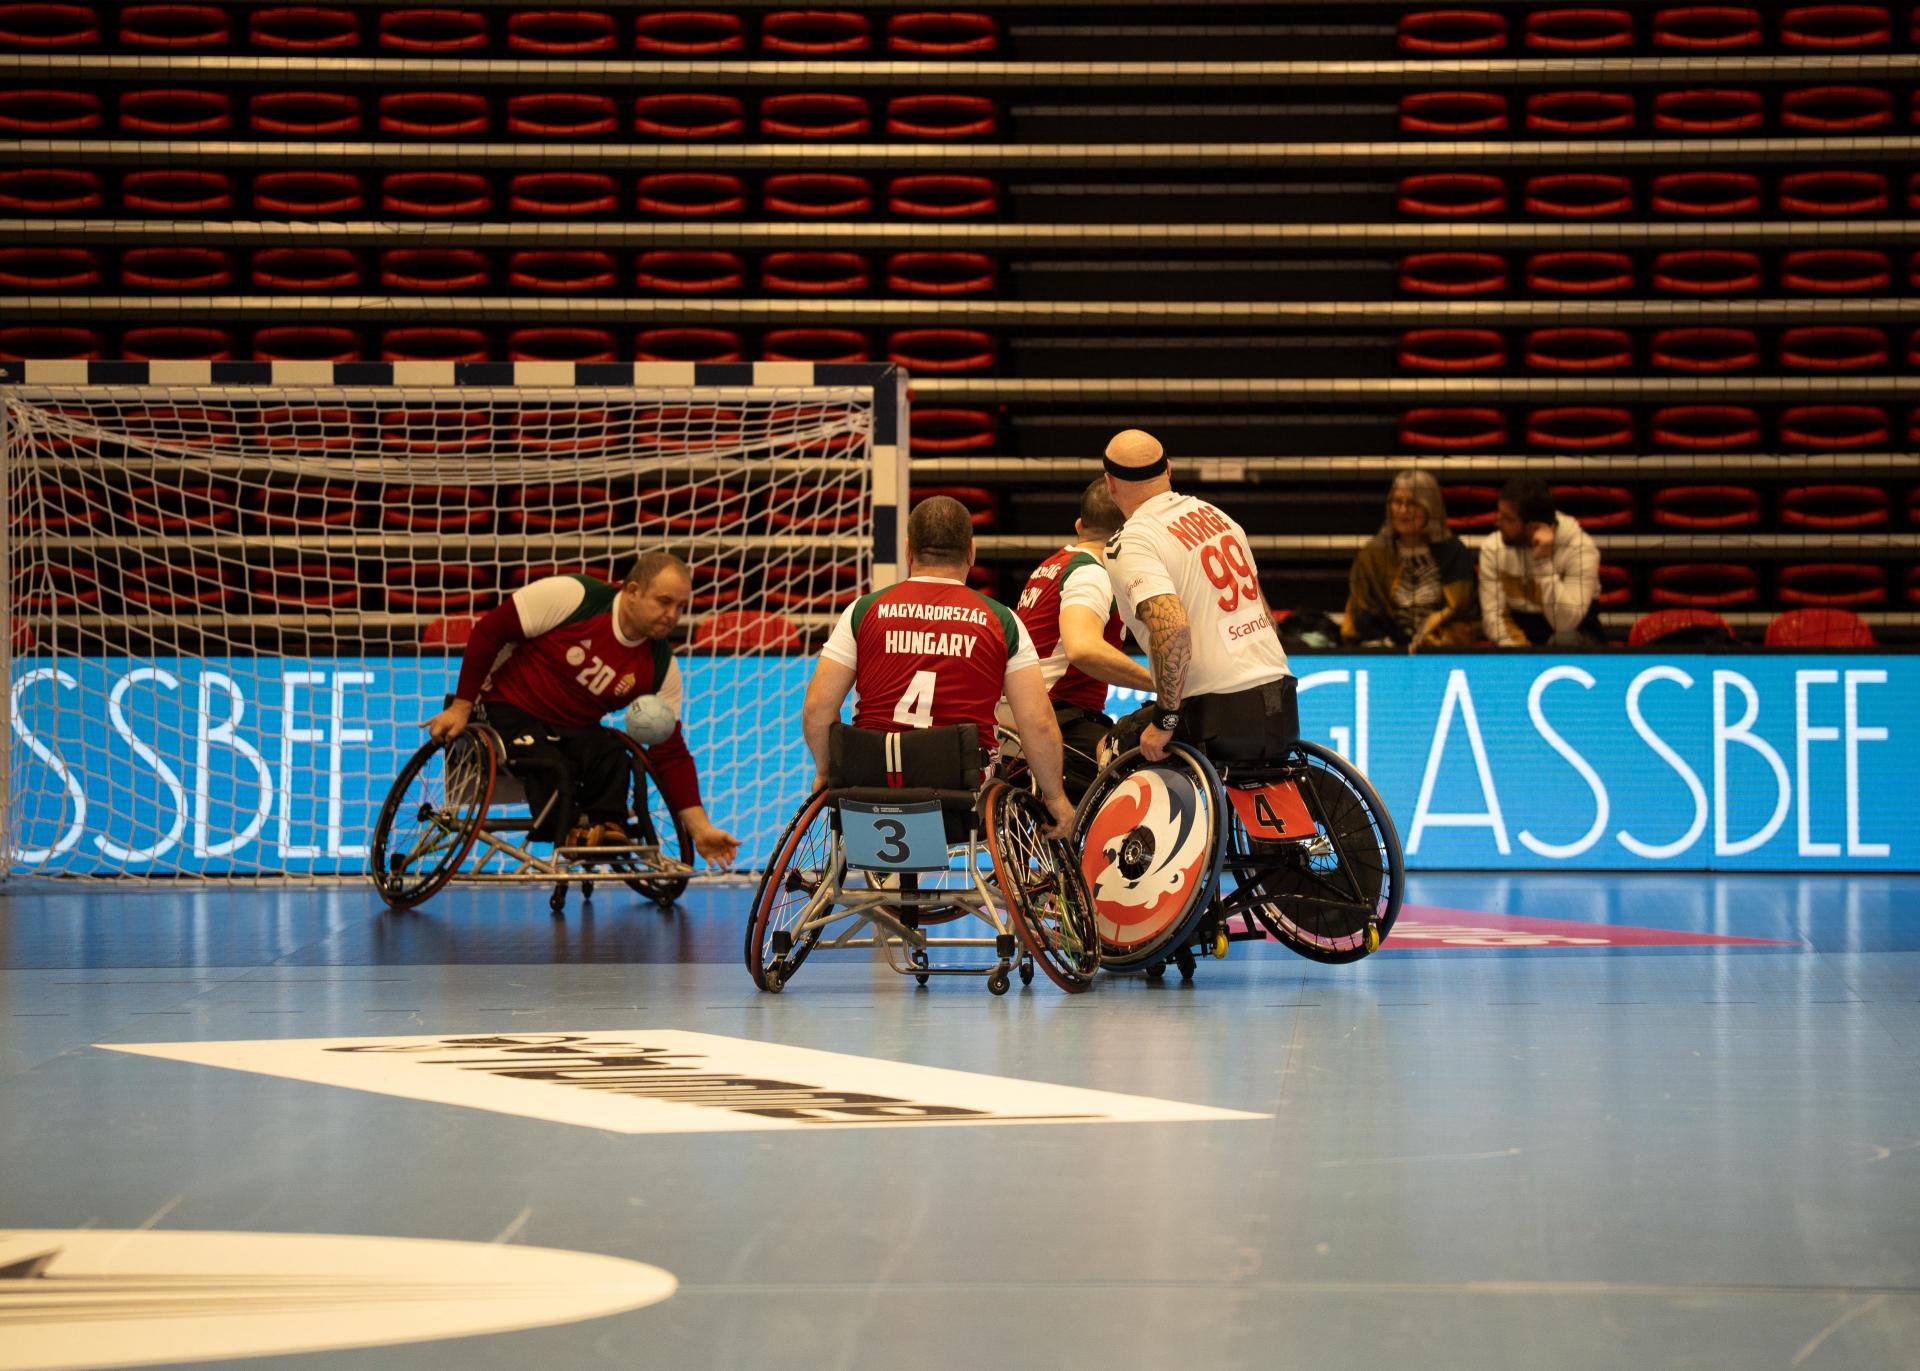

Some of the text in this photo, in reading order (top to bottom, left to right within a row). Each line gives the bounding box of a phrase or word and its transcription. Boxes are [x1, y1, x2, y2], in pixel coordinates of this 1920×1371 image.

[1167, 505, 1232, 552] NORGE
[1200, 535, 1258, 612] 99
[878, 603, 987, 625] MAGYARORSZÁG
[885, 630, 977, 658] HUNGARY
[575, 656, 616, 695] 20
[892, 670, 937, 728] 4
[10, 667, 375, 863] SSBEE
[1296, 664, 1890, 859] LASSBEE
[1254, 793, 1287, 834] 4
[873, 818, 911, 864] 3
